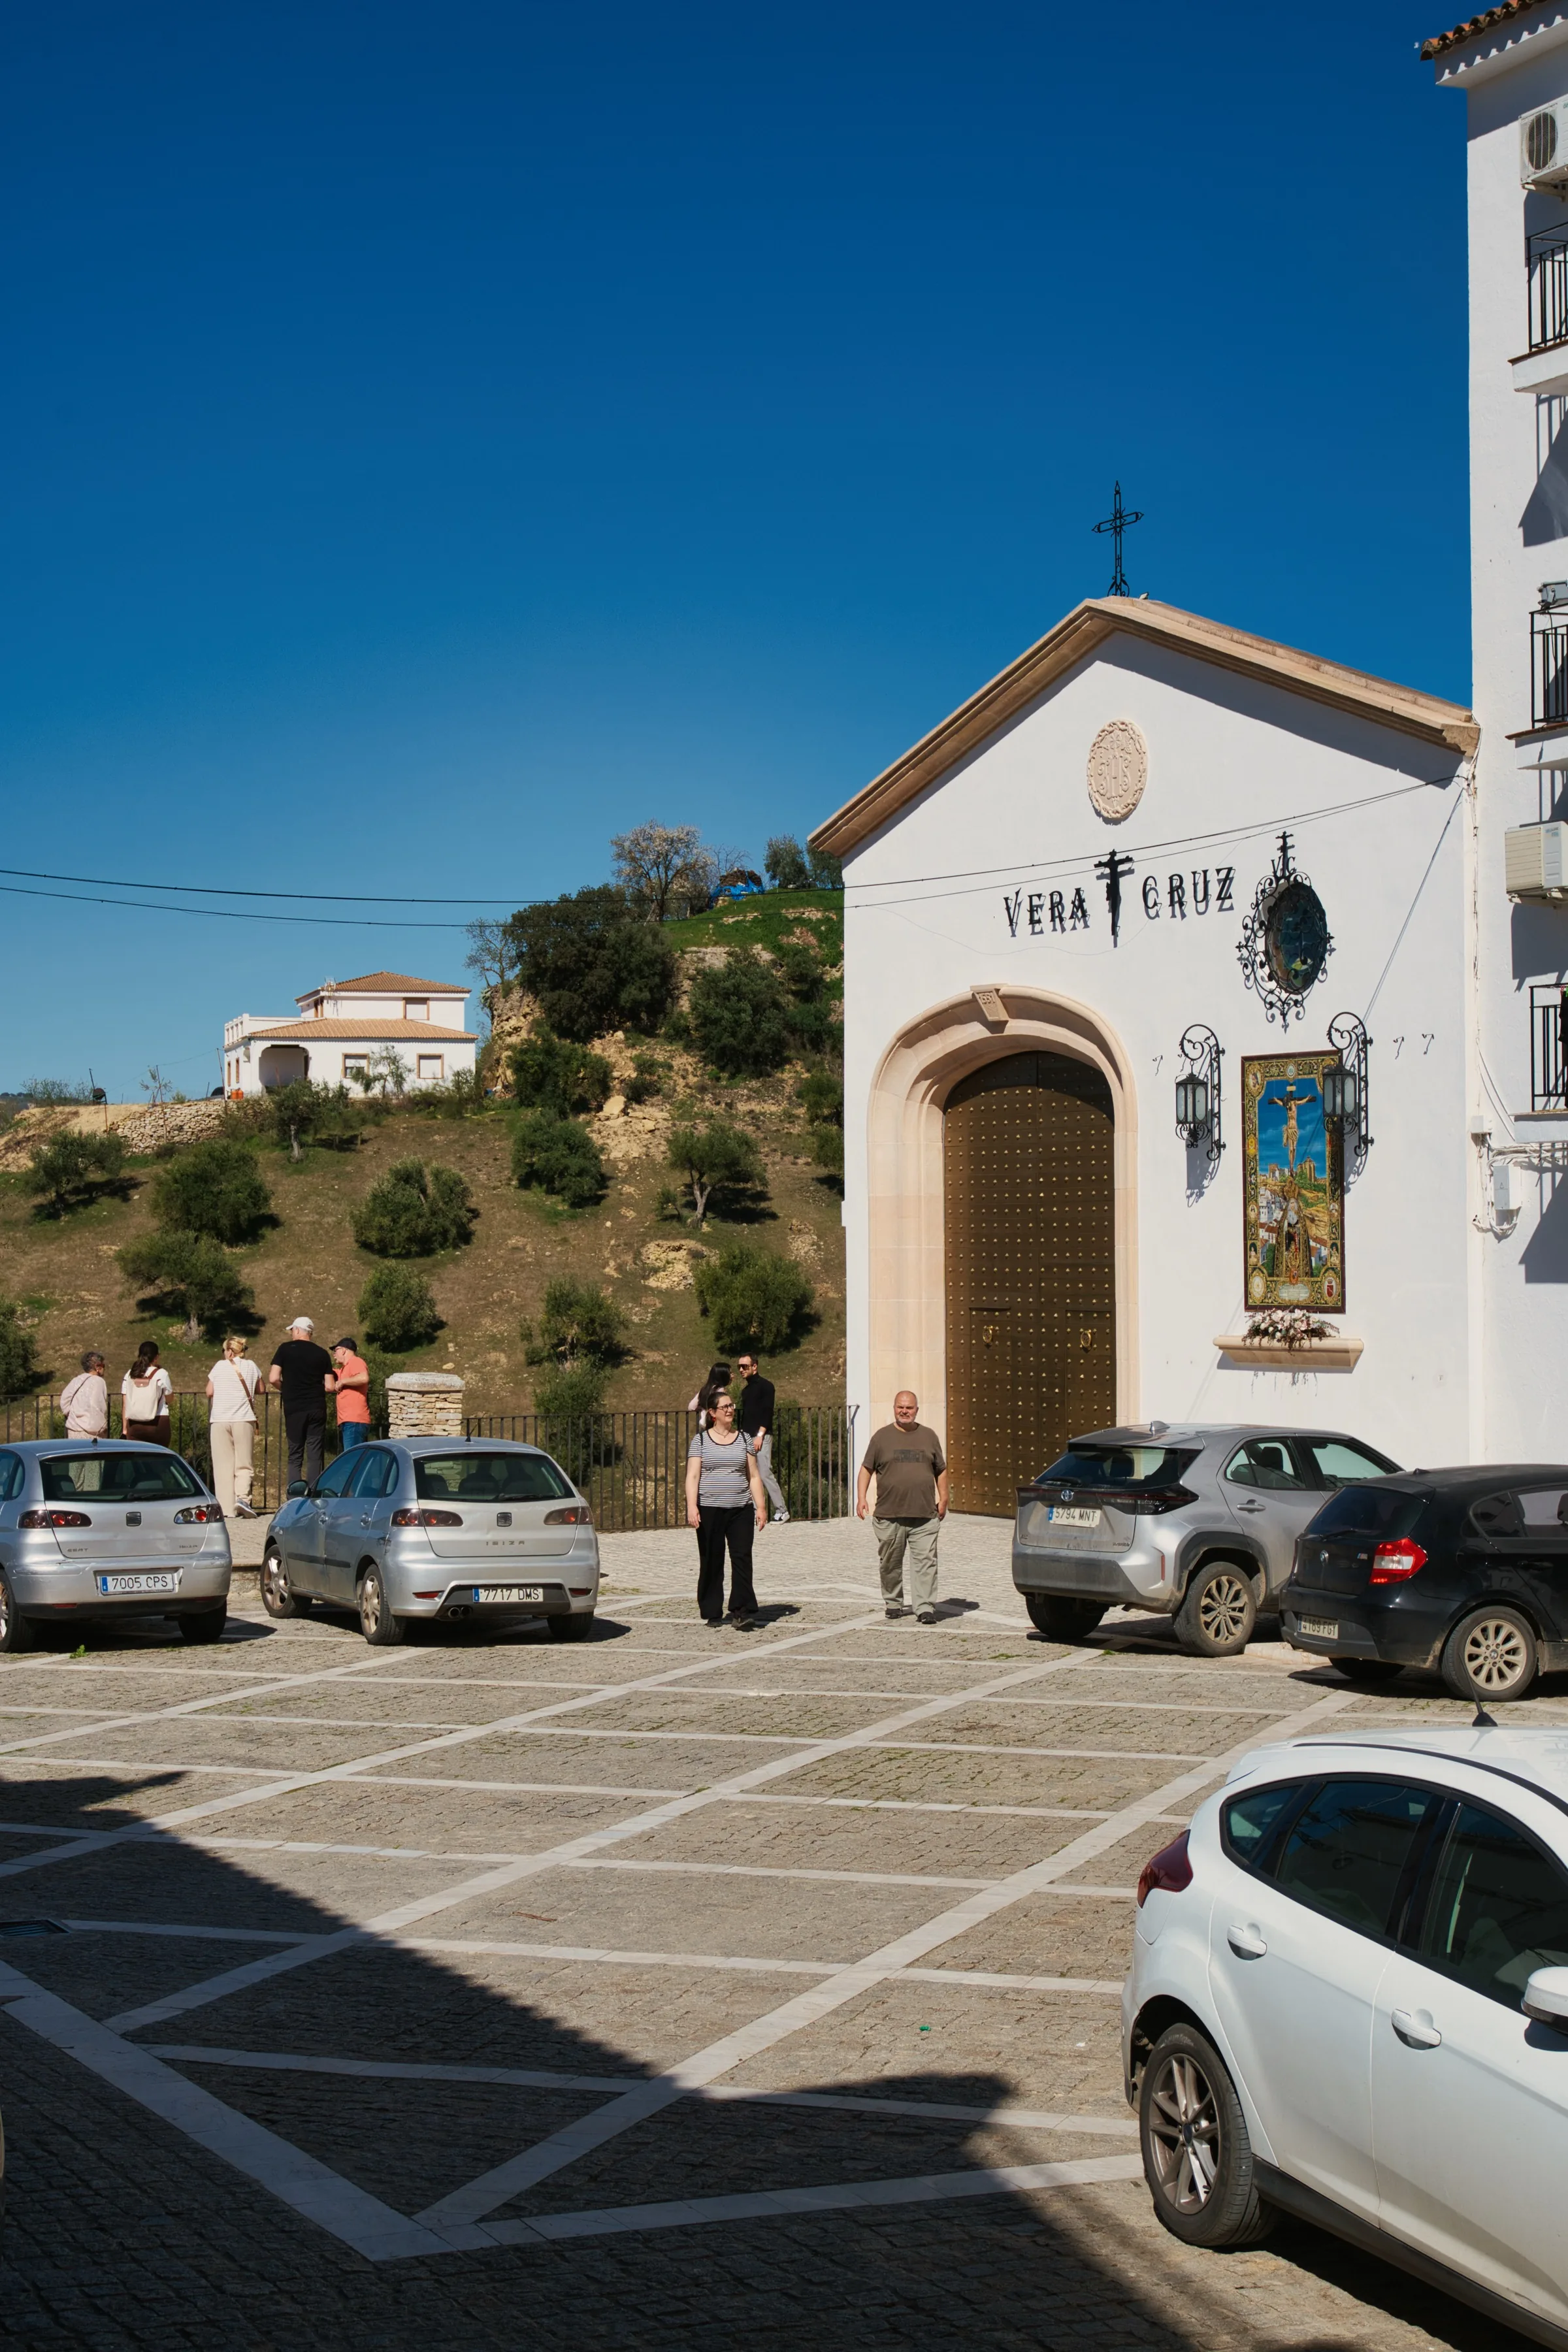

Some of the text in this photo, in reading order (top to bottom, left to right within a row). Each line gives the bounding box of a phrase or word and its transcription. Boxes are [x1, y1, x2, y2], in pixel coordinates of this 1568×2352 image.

[1004, 866, 1233, 926] VERA CRUZ
[1055, 1507, 1097, 1522] 5794 MNT
[112, 1576, 168, 1590] 7005 CPS
[483, 1588, 539, 1601] 7717 DMS
